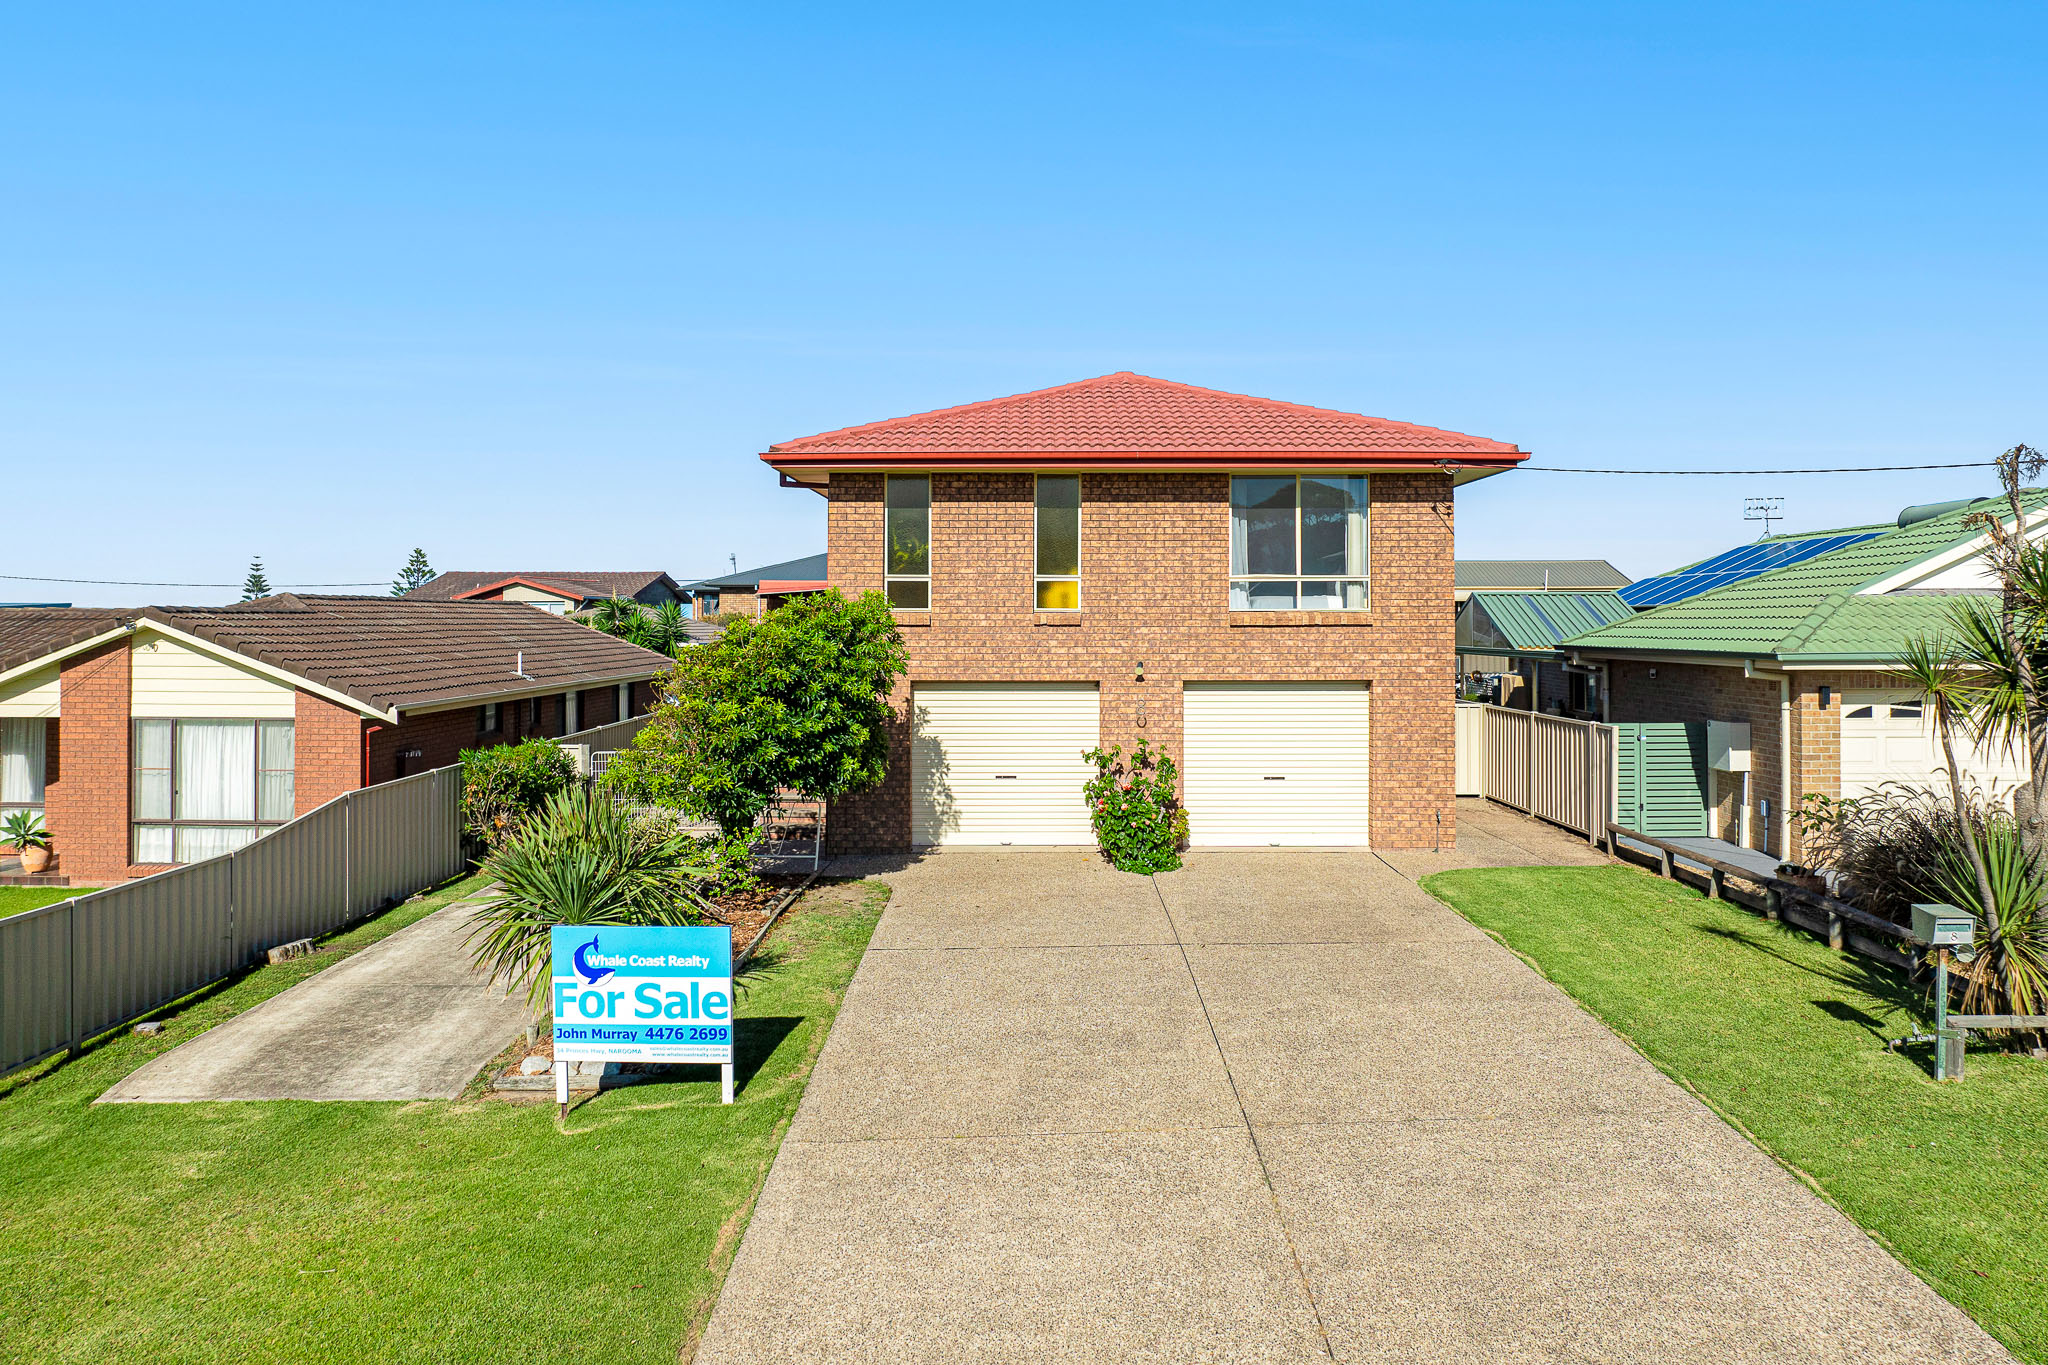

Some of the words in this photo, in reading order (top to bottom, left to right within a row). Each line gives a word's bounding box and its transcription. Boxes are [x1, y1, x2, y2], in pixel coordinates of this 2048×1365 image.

[1950, 931, 1958, 941] 8
[586, 954, 627, 967] Whale
[629, 954, 665, 967] Coast
[668, 955, 710, 969] Realty
[554, 982, 625, 1019] For
[634, 981, 729, 1020] Sale
[556, 1028, 587, 1039] John
[592, 1029, 638, 1042] Murray
[645, 1027, 684, 1041] 4476
[689, 1028, 728, 1041] 2699
